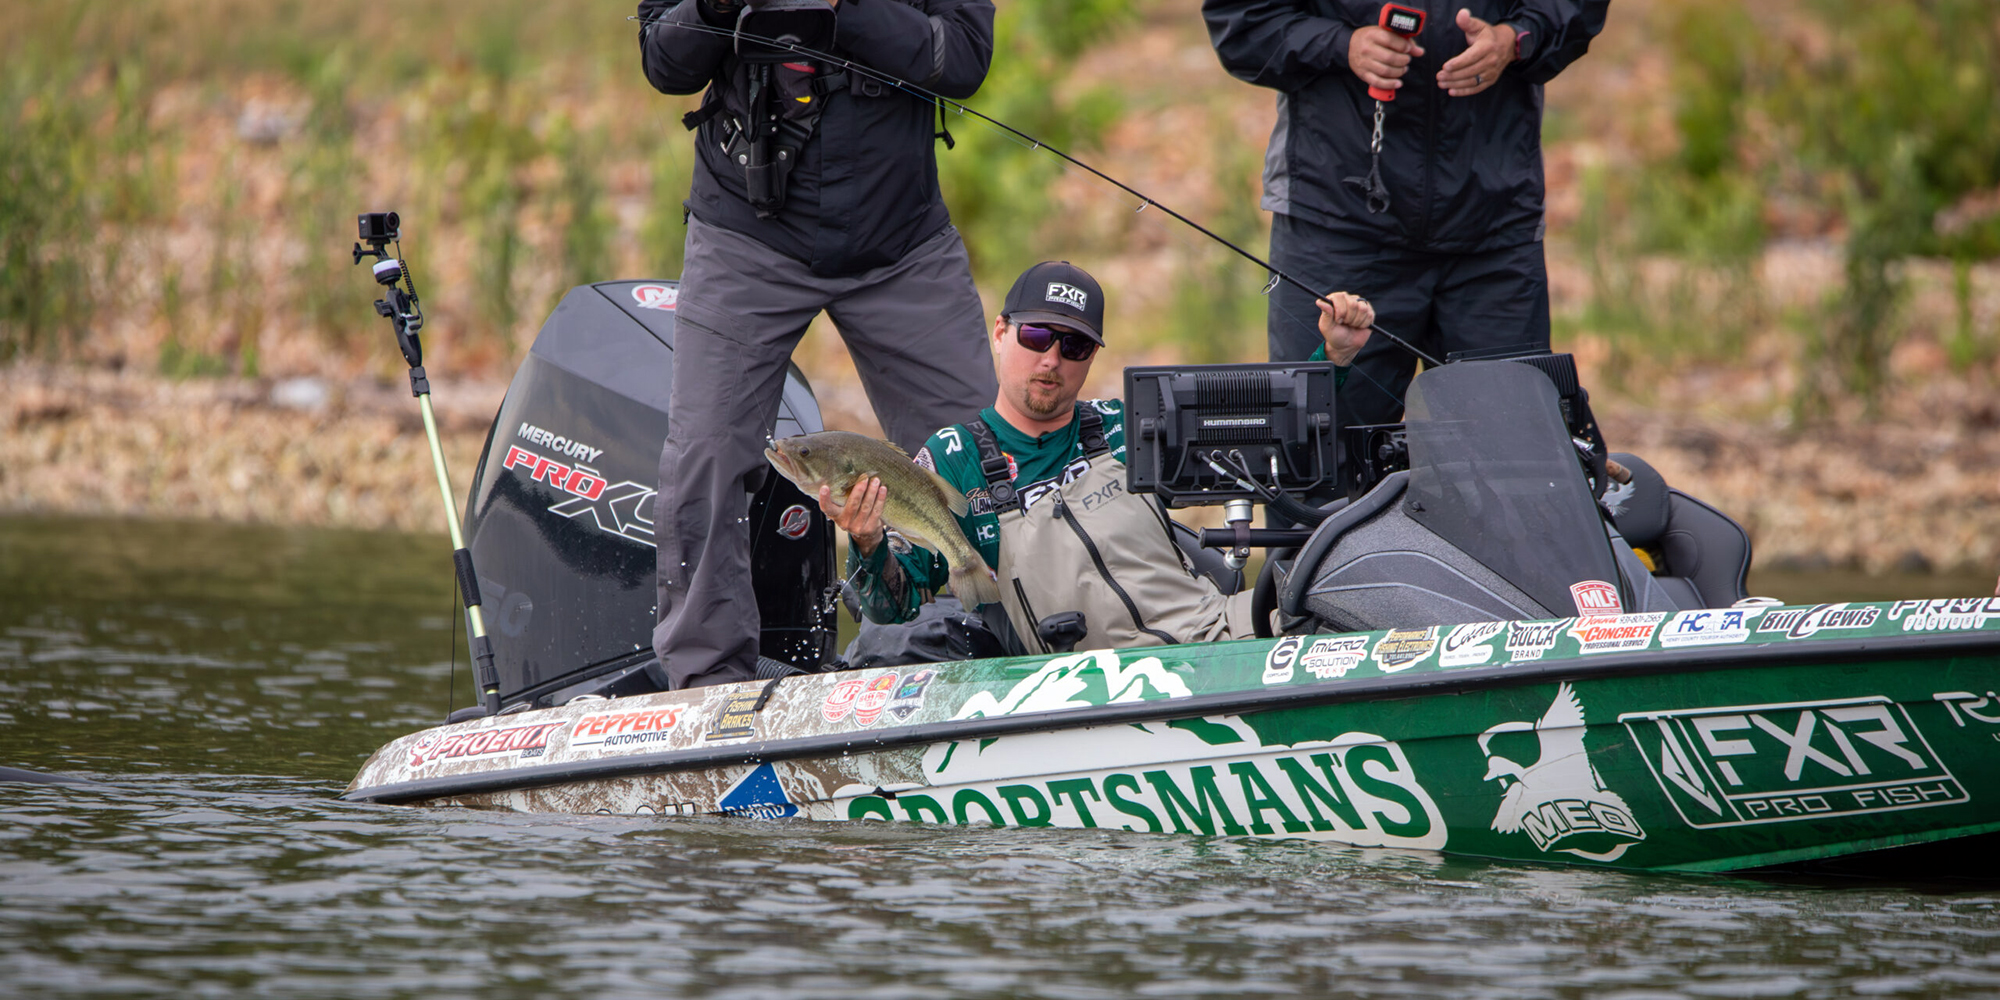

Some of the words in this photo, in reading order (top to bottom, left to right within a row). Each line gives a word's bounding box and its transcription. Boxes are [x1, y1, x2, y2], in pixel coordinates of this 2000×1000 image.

[1049, 284, 1085, 305] FXR
[1203, 418, 1266, 427] HUMMINBIRD
[517, 421, 604, 464] MERCURY
[502, 444, 608, 502] PRO
[1081, 478, 1123, 511] FXR
[1580, 589, 1619, 609] MLF
[1583, 625, 1655, 642] CONCRETE
[1310, 639, 1366, 653] MICRO
[1514, 649, 1542, 659] BRAND
[1308, 656, 1358, 668] SOLUTION
[724, 700, 757, 713] FISHIN
[573, 707, 684, 737] PEPPERS
[720, 713, 754, 730] BRAKES
[427, 720, 569, 761] PHOENIX
[604, 731, 668, 747] AUTOMOTIVE
[1692, 704, 1929, 786] FXR
[1744, 795, 1832, 818] PRO
[1852, 782, 1954, 808] FISH
